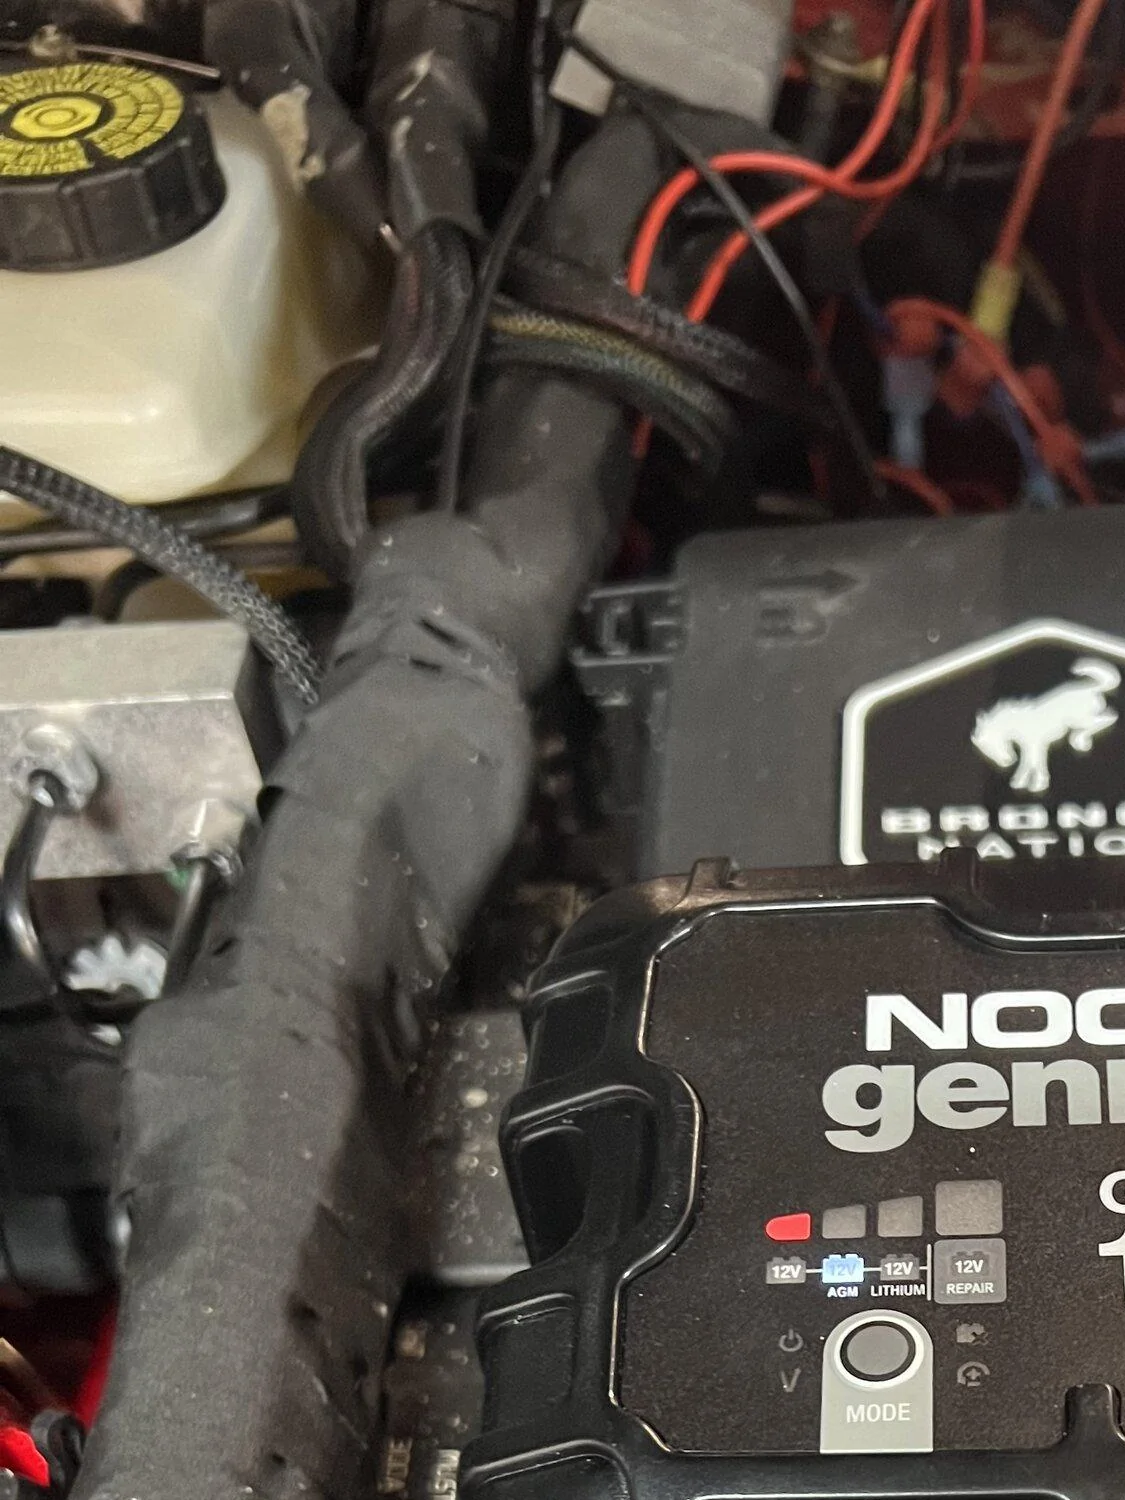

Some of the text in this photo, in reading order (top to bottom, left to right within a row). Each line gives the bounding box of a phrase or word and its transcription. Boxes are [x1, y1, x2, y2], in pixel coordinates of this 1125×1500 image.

[771, 1265, 802, 1280] 12V
[829, 1261, 857, 1276] 12V
[884, 1261, 914, 1276] 12V
[955, 1259, 984, 1274] 12V
[827, 1286, 859, 1298] AGM
[870, 1284, 926, 1297] LITHIUM
[946, 1282, 994, 1295] REPAIR
[845, 1402, 911, 1423] MODE
